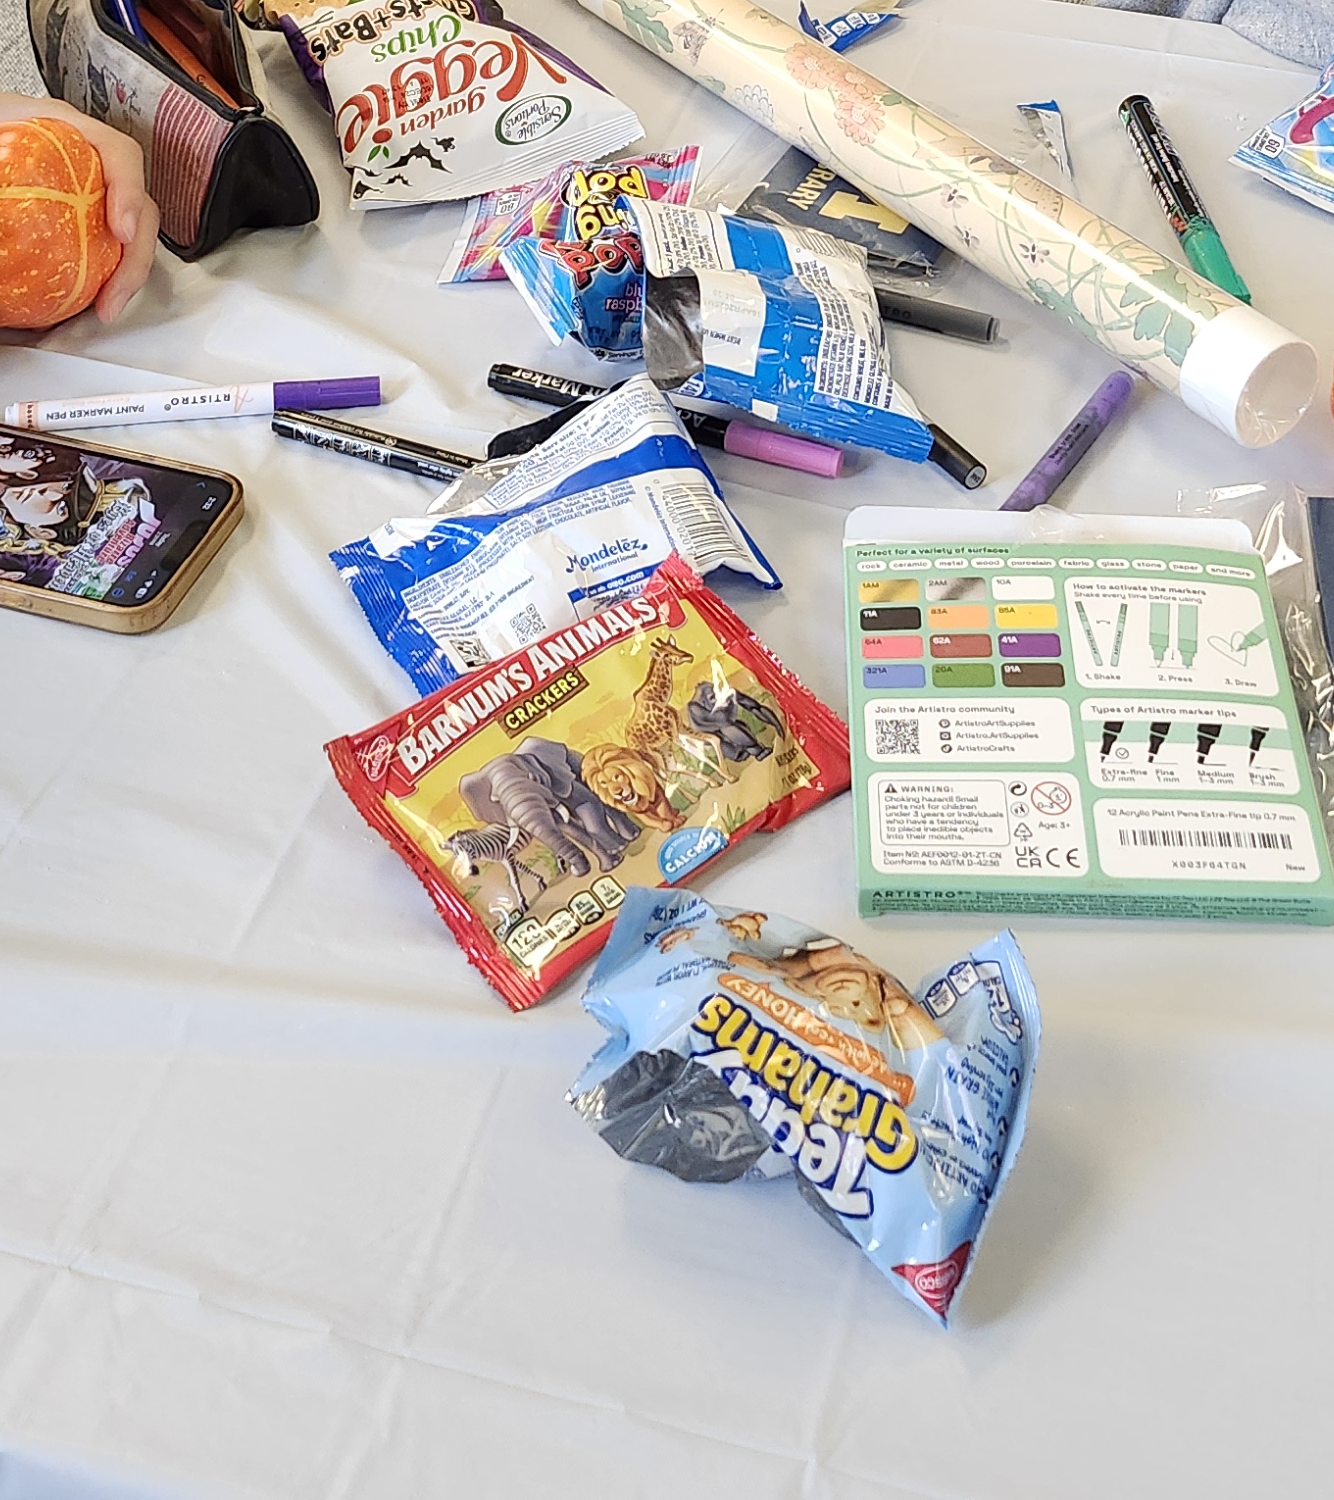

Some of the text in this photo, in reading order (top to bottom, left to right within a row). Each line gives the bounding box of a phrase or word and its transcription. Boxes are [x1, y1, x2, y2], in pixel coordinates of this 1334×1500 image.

[371, 15, 462, 63] Chips
[334, 33, 567, 154] Veggie
[400, 86, 487, 135] garden
[503, 98, 549, 130] Portions
[515, 106, 564, 141] Sensible
[787, 163, 838, 211] RARY
[46, 405, 145, 420] PAINT MARKER PEN
[857, 549, 891, 557] Perfect
[919, 547, 952, 555] variety
[1109, 584, 1148, 592] activate
[1169, 587, 1206, 595] markers
[1179, 596, 1203, 604] using
[1094, 673, 1121, 681] Shake
[395, 596, 657, 775] BARNUM'S ANIMALS
[1235, 679, 1257, 687] Draw
[504, 670, 580, 730] CRACKERS
[958, 706, 1015, 714] community
[1091, 706, 1121, 714] Types
[1138, 706, 1176, 714] Artistro
[1179, 708, 1214, 716] marker
[1217, 709, 1237, 717] tips
[1197, 770, 1235, 778] Medium
[1119, 809, 1149, 817] Acrylic
[1177, 810, 1199, 818] Pens
[1201, 811, 1247, 819] Extra-Fine
[1250, 812, 1262, 821] tip
[898, 826, 922, 834] place
[960, 826, 993, 834] objects
[1038, 822, 1058, 830] Age:
[1015, 846, 1039, 856] UK
[873, 890, 956, 898] ARTISTRO
[727, 977, 800, 1026] HONEY
[693, 993, 919, 1175] Grahams
